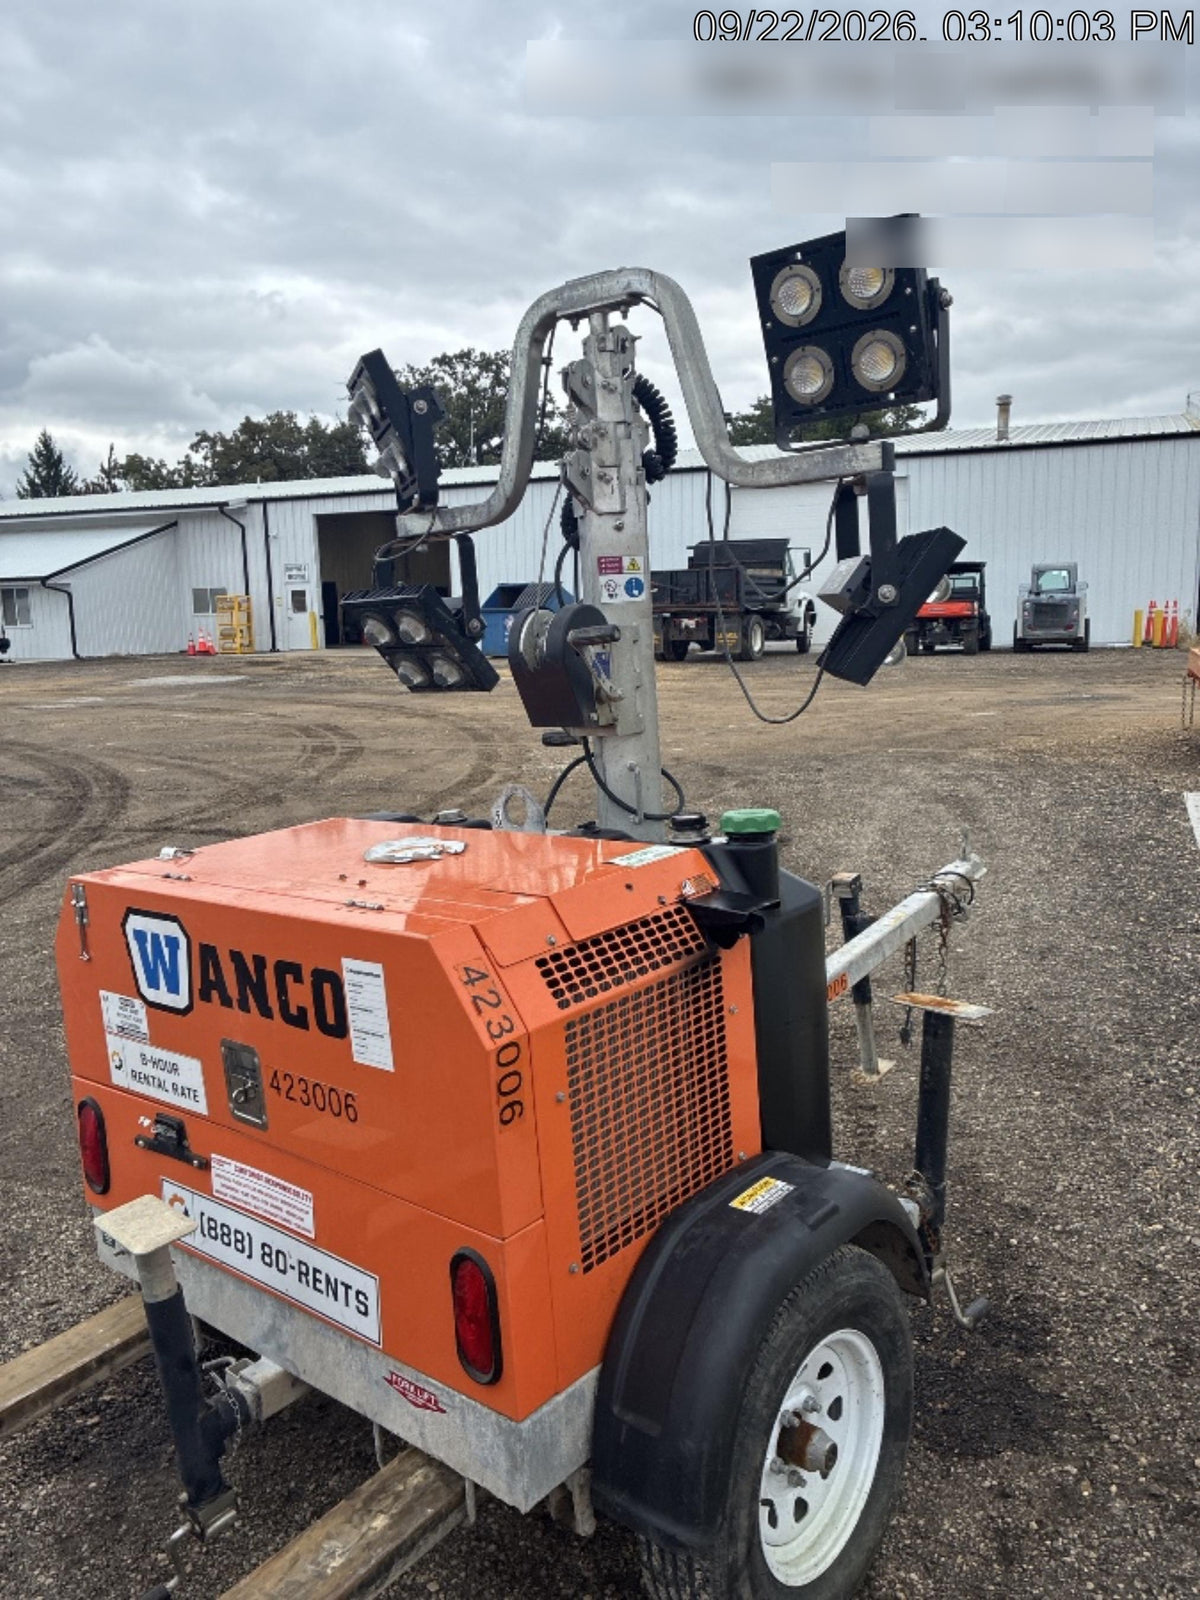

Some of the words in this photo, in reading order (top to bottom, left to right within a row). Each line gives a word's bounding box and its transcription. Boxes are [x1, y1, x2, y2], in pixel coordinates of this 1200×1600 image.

[131, 926, 348, 1040] WANCO
[130, 1068, 170, 1094] RENTAL
[171, 1081, 201, 1104] RATE
[269, 1070, 359, 1123] 423006
[463, 966, 524, 1126] 423006
[200, 1211, 253, 1260] (888)
[260, 1241, 369, 1318] 80-RENTS
